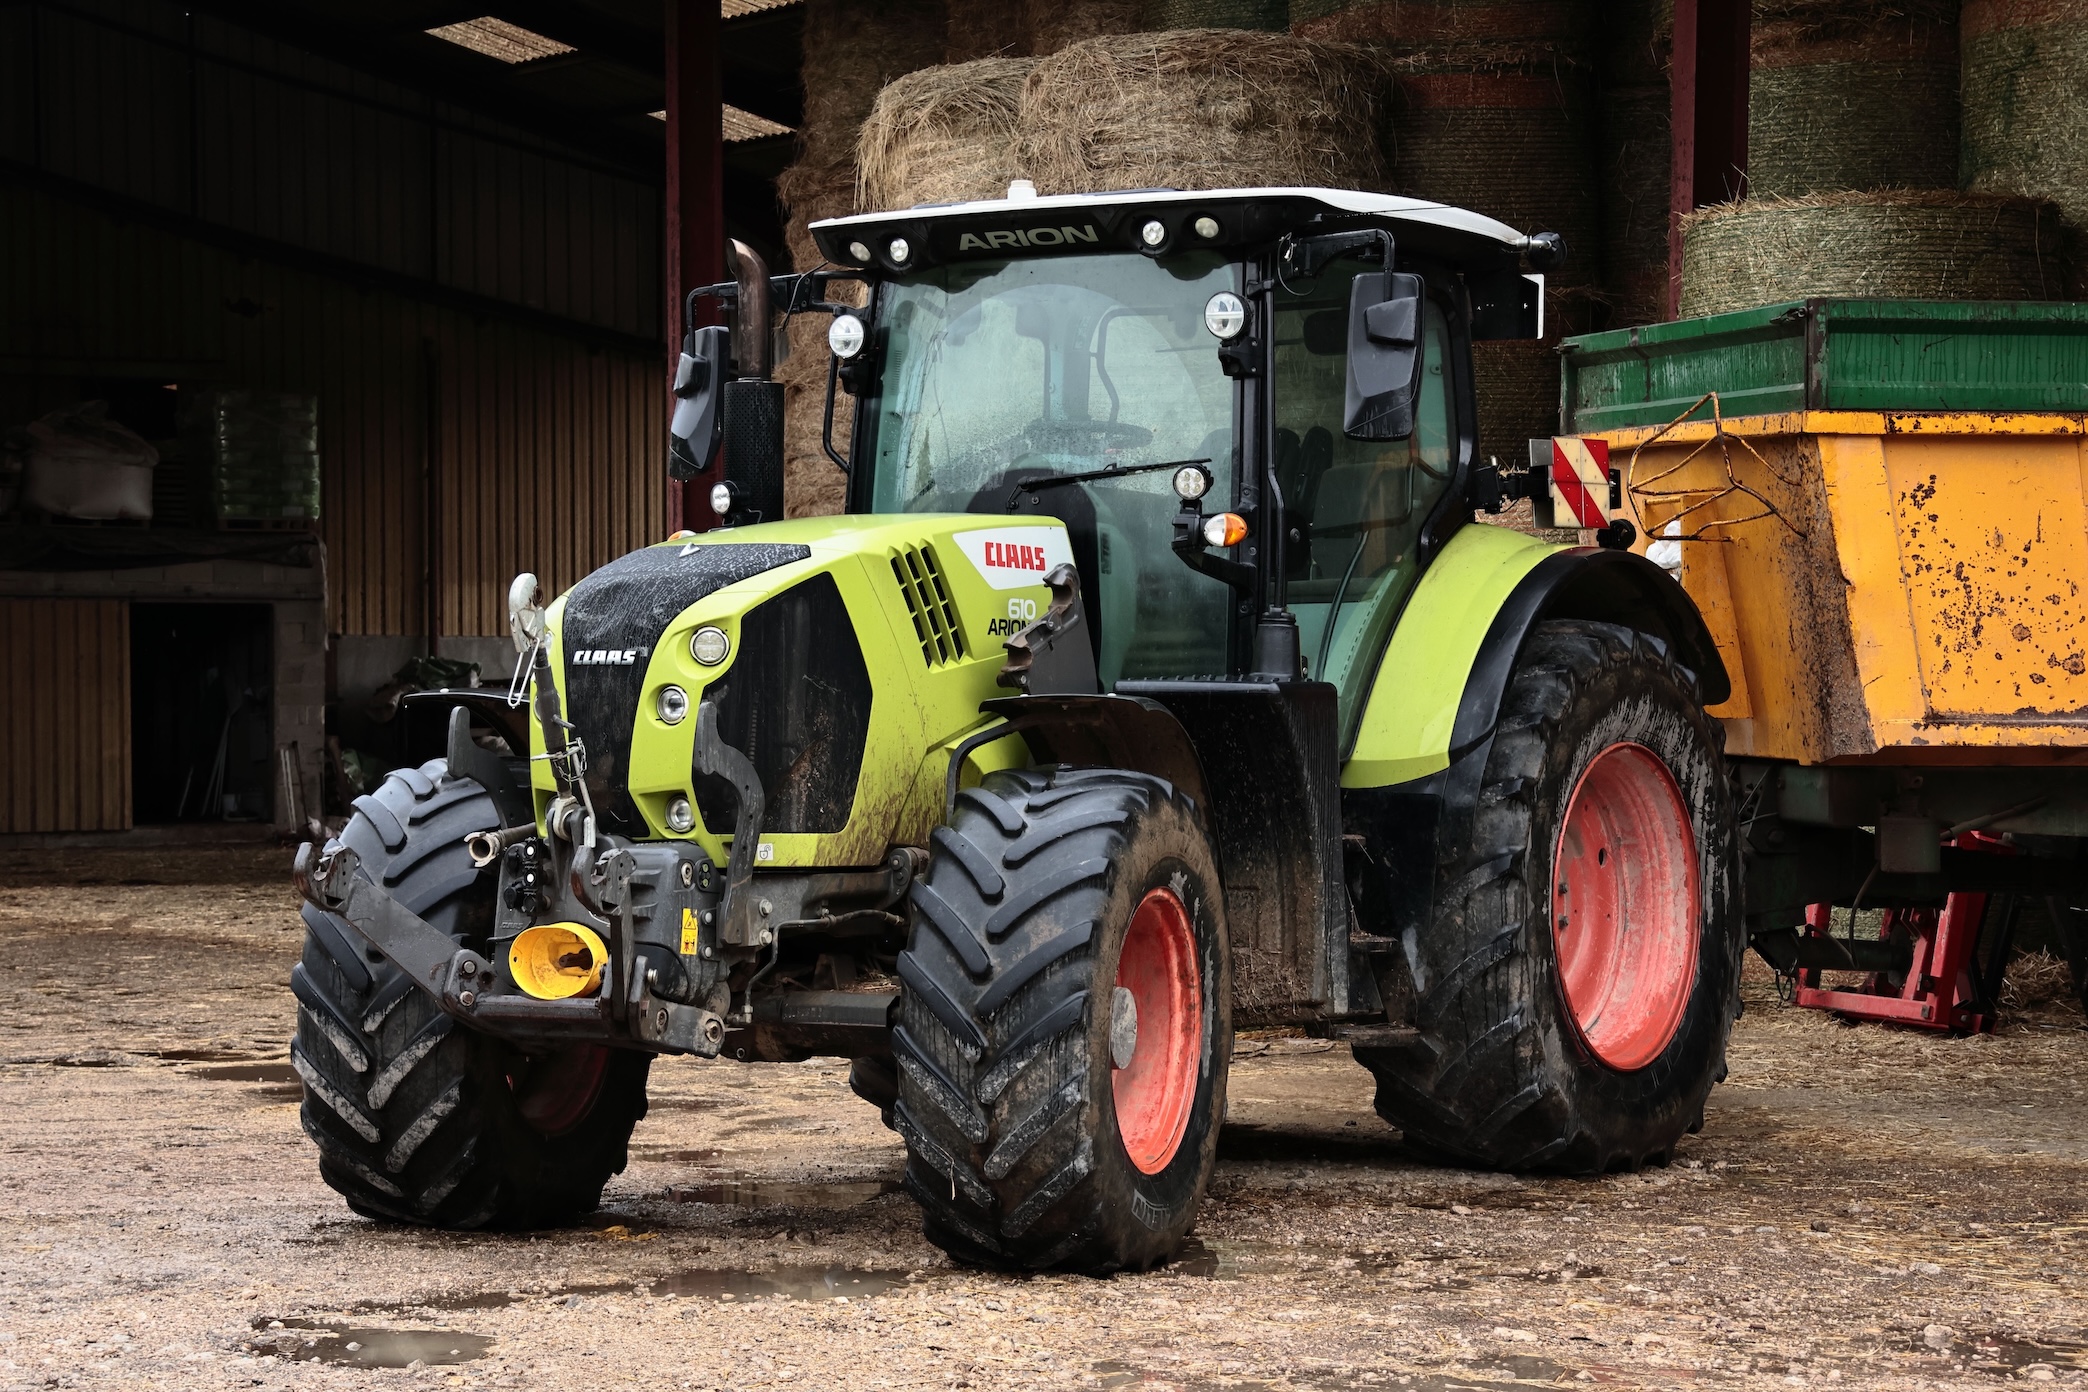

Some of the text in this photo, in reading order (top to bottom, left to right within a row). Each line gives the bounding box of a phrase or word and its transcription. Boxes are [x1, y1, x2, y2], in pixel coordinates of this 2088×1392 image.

[959, 224, 1100, 251] ARION
[985, 541, 1046, 571] CLAAS
[1008, 598, 1036, 620] 610
[572, 650, 637, 666] CLAAS
